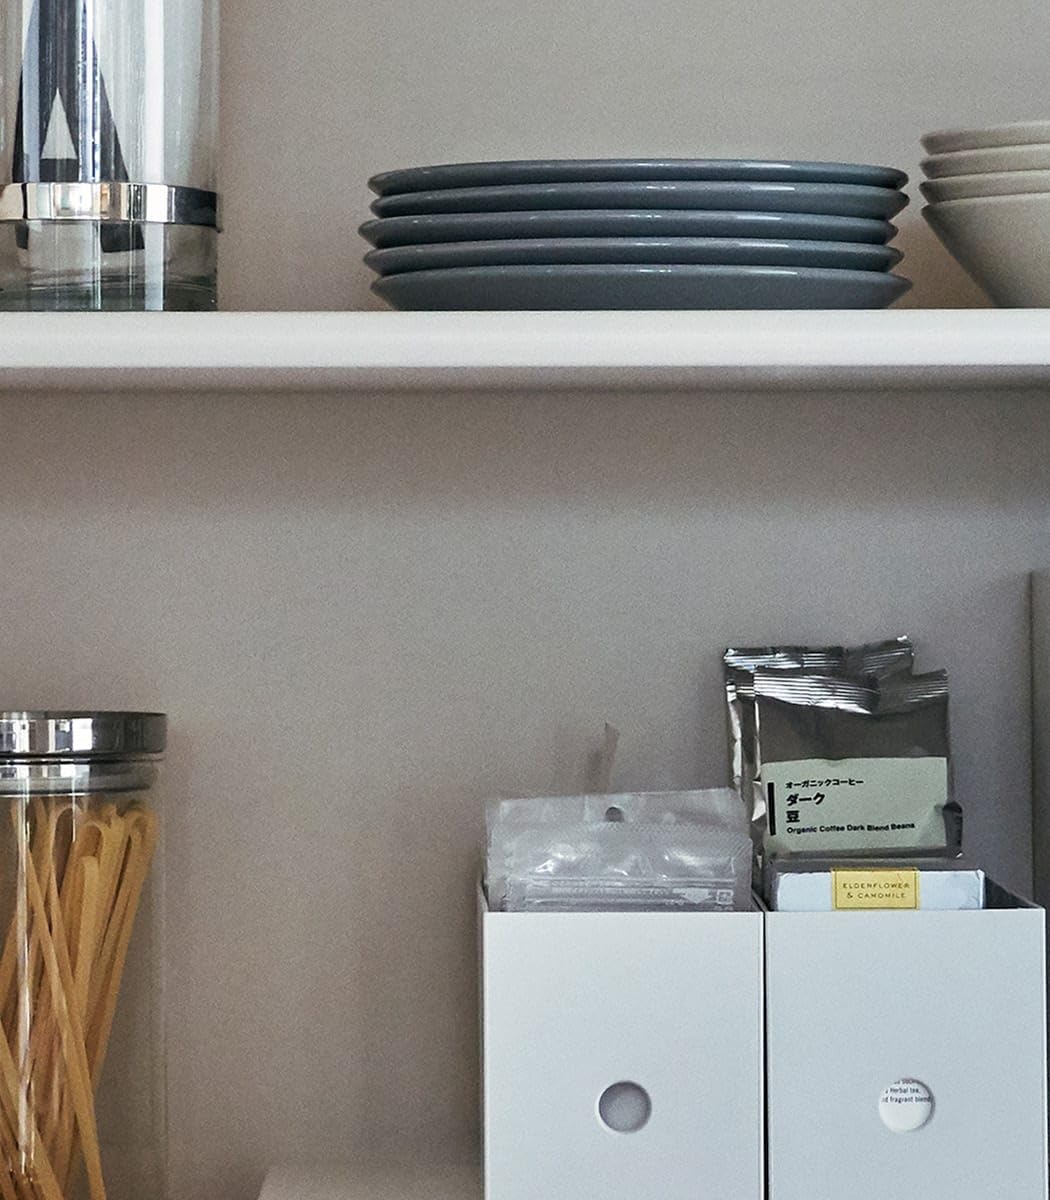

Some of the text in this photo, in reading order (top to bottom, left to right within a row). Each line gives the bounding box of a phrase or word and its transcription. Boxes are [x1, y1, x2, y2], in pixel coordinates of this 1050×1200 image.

[785, 778, 864, 789] オーガニックコーヒー
[786, 792, 825, 806] ダーク
[786, 810, 800, 823] 豆
[786, 822, 915, 835] Organic Coffee Dark Blend Beans
